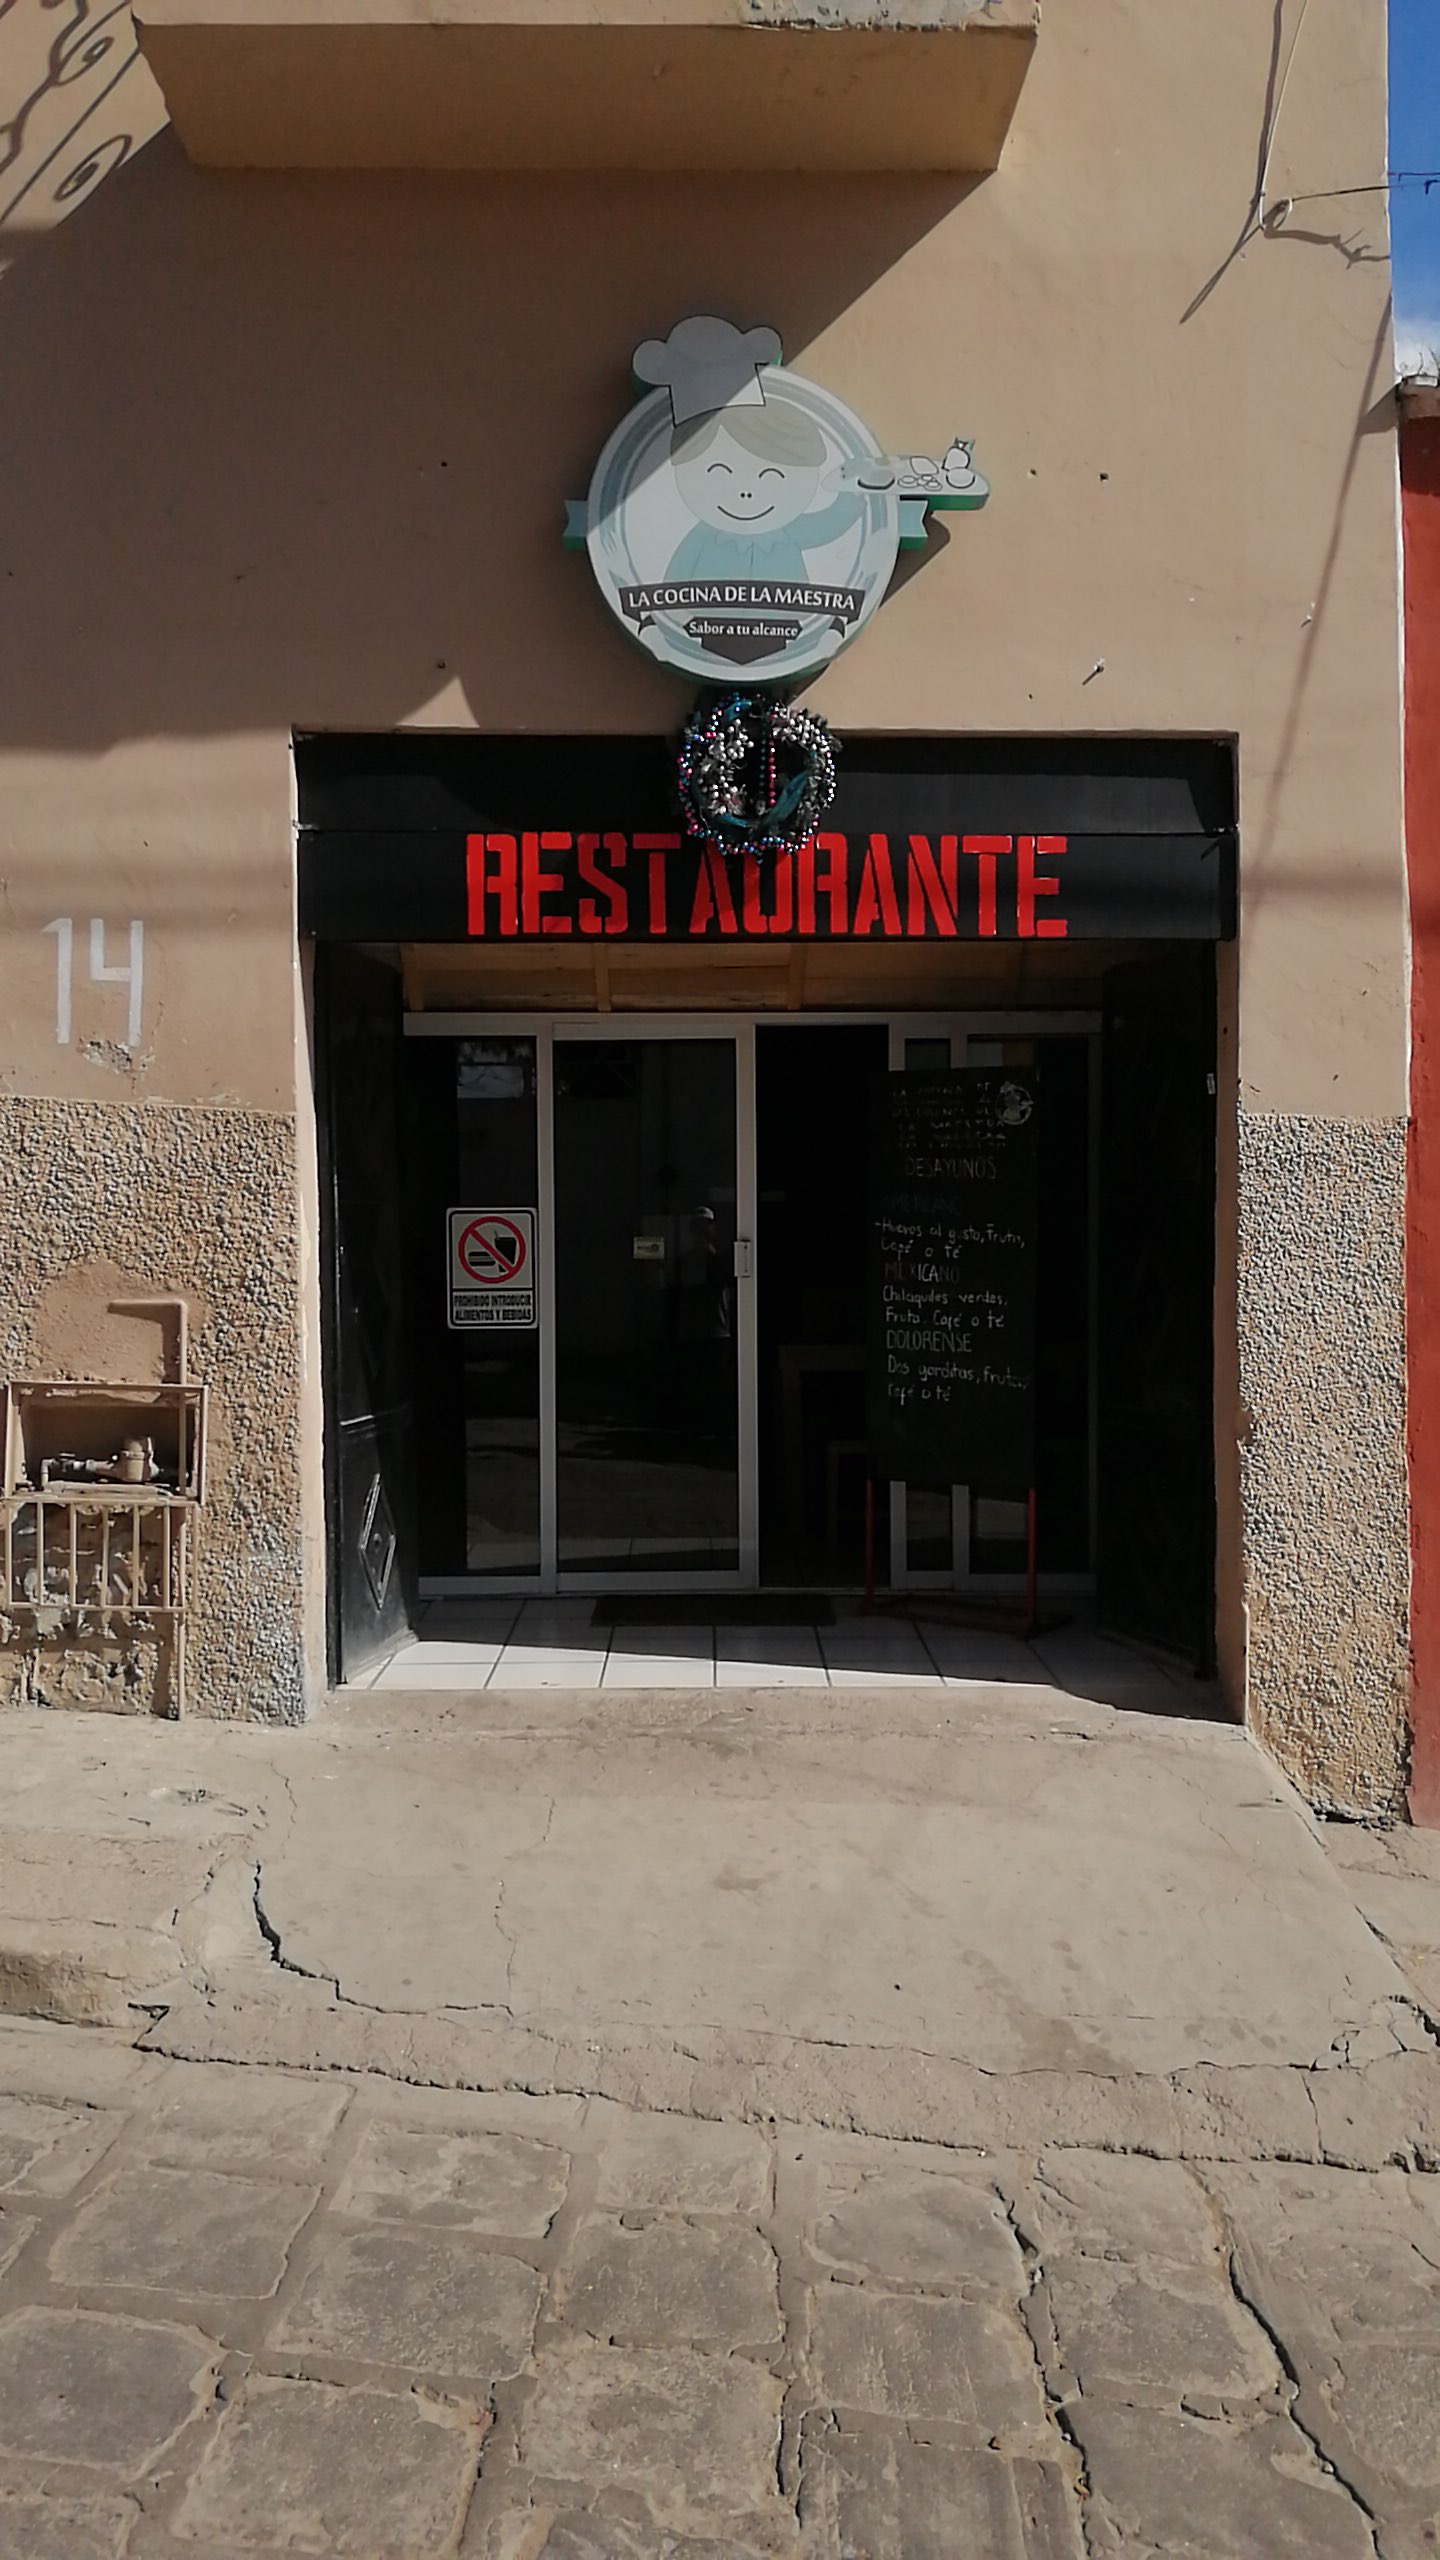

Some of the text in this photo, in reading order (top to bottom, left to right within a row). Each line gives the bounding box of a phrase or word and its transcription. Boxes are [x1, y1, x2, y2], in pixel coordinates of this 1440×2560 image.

[629, 585, 856, 610] LA COCINA DE LA MAESTRA
[689, 621, 799, 638] Sabor a tu alcance
[466, 832, 1068, 938] RESTAURANTE
[41, 917, 143, 1047] 14
[929, 1222, 942, 1237] al
[925, 1247, 934, 1258] o
[971, 1316, 980, 1327] o
[886, 1329, 973, 1353] DOLORENSE
